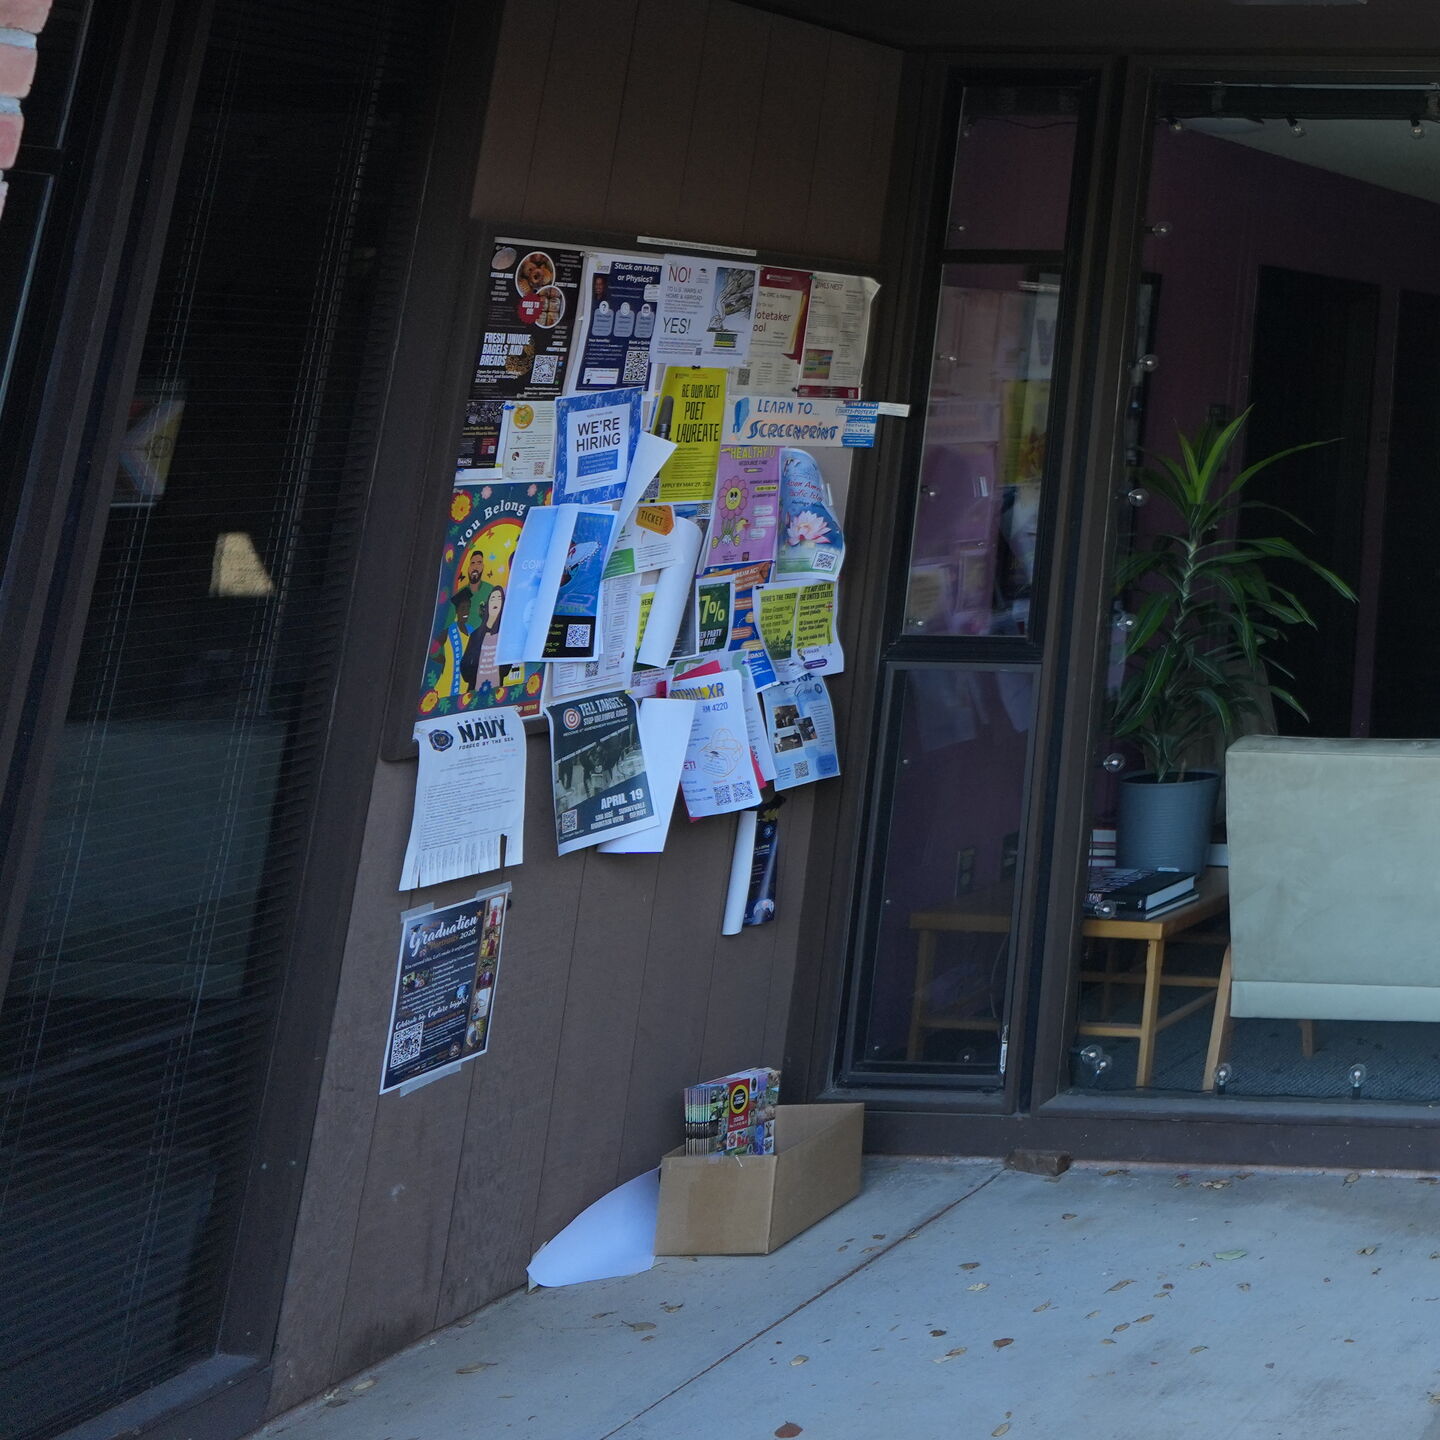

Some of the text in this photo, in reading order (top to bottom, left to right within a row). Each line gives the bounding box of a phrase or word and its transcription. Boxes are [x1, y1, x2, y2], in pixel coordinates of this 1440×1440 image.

[614, 262, 633, 271] Stuck
[669, 266, 692, 283] NO!
[626, 275, 653, 283] Physics?
[663, 318, 691, 334] YES!
[752, 323, 767, 334] ool
[484, 332, 507, 344] FRESH
[507, 333, 532, 345] UNIQUE
[482, 344, 523, 357] BAGELS AND
[479, 355, 507, 367] BREADS
[682, 384, 720, 399] BE OUR NEXT
[684, 401, 706, 420] POET
[757, 399, 794, 414] LEARN
[577, 417, 620, 436] WE'RE
[676, 423, 720, 443] LAUREATE
[576, 432, 621, 452] HIRING
[730, 446, 768, 459] HEALTHY
[457, 499, 527, 547] You Belong
[640, 511, 664, 527] TICKET
[670, 682, 725, 700] OTHILL XR
[578, 697, 627, 717] TELL TARGET:
[712, 702, 729, 712] 4220
[457, 719, 507, 743] NAVY
[459, 742, 480, 750] FORGED
[601, 788, 644, 810] APRIL 19
[409, 914, 479, 958] Graduation
